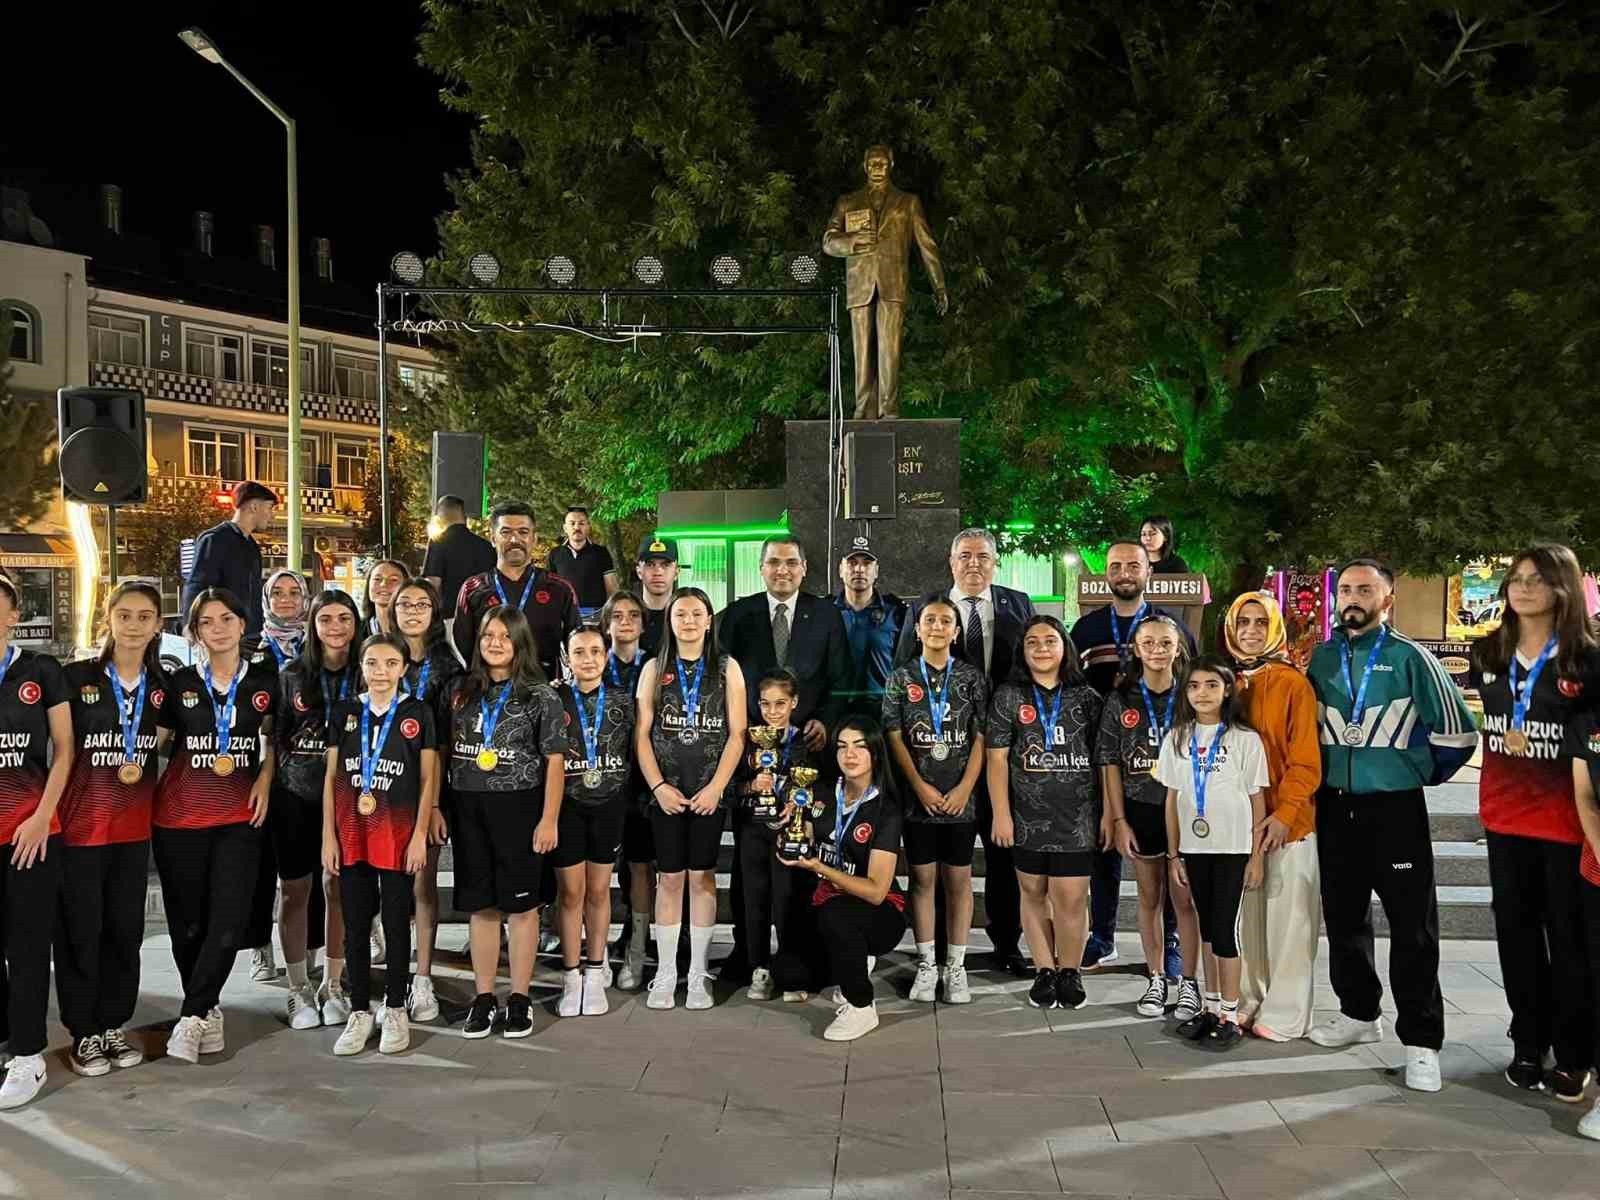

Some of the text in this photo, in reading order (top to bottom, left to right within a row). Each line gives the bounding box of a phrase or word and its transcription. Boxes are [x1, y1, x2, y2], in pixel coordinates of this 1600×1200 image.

[160, 315, 170, 361] CHP
[1081, 580, 1200, 594] BOZK LEDİYESİ
[0, 733, 31, 748] ZUCU
[84, 730, 113, 748] BAKİ
[1489, 734, 1559, 759] OTOTİV
